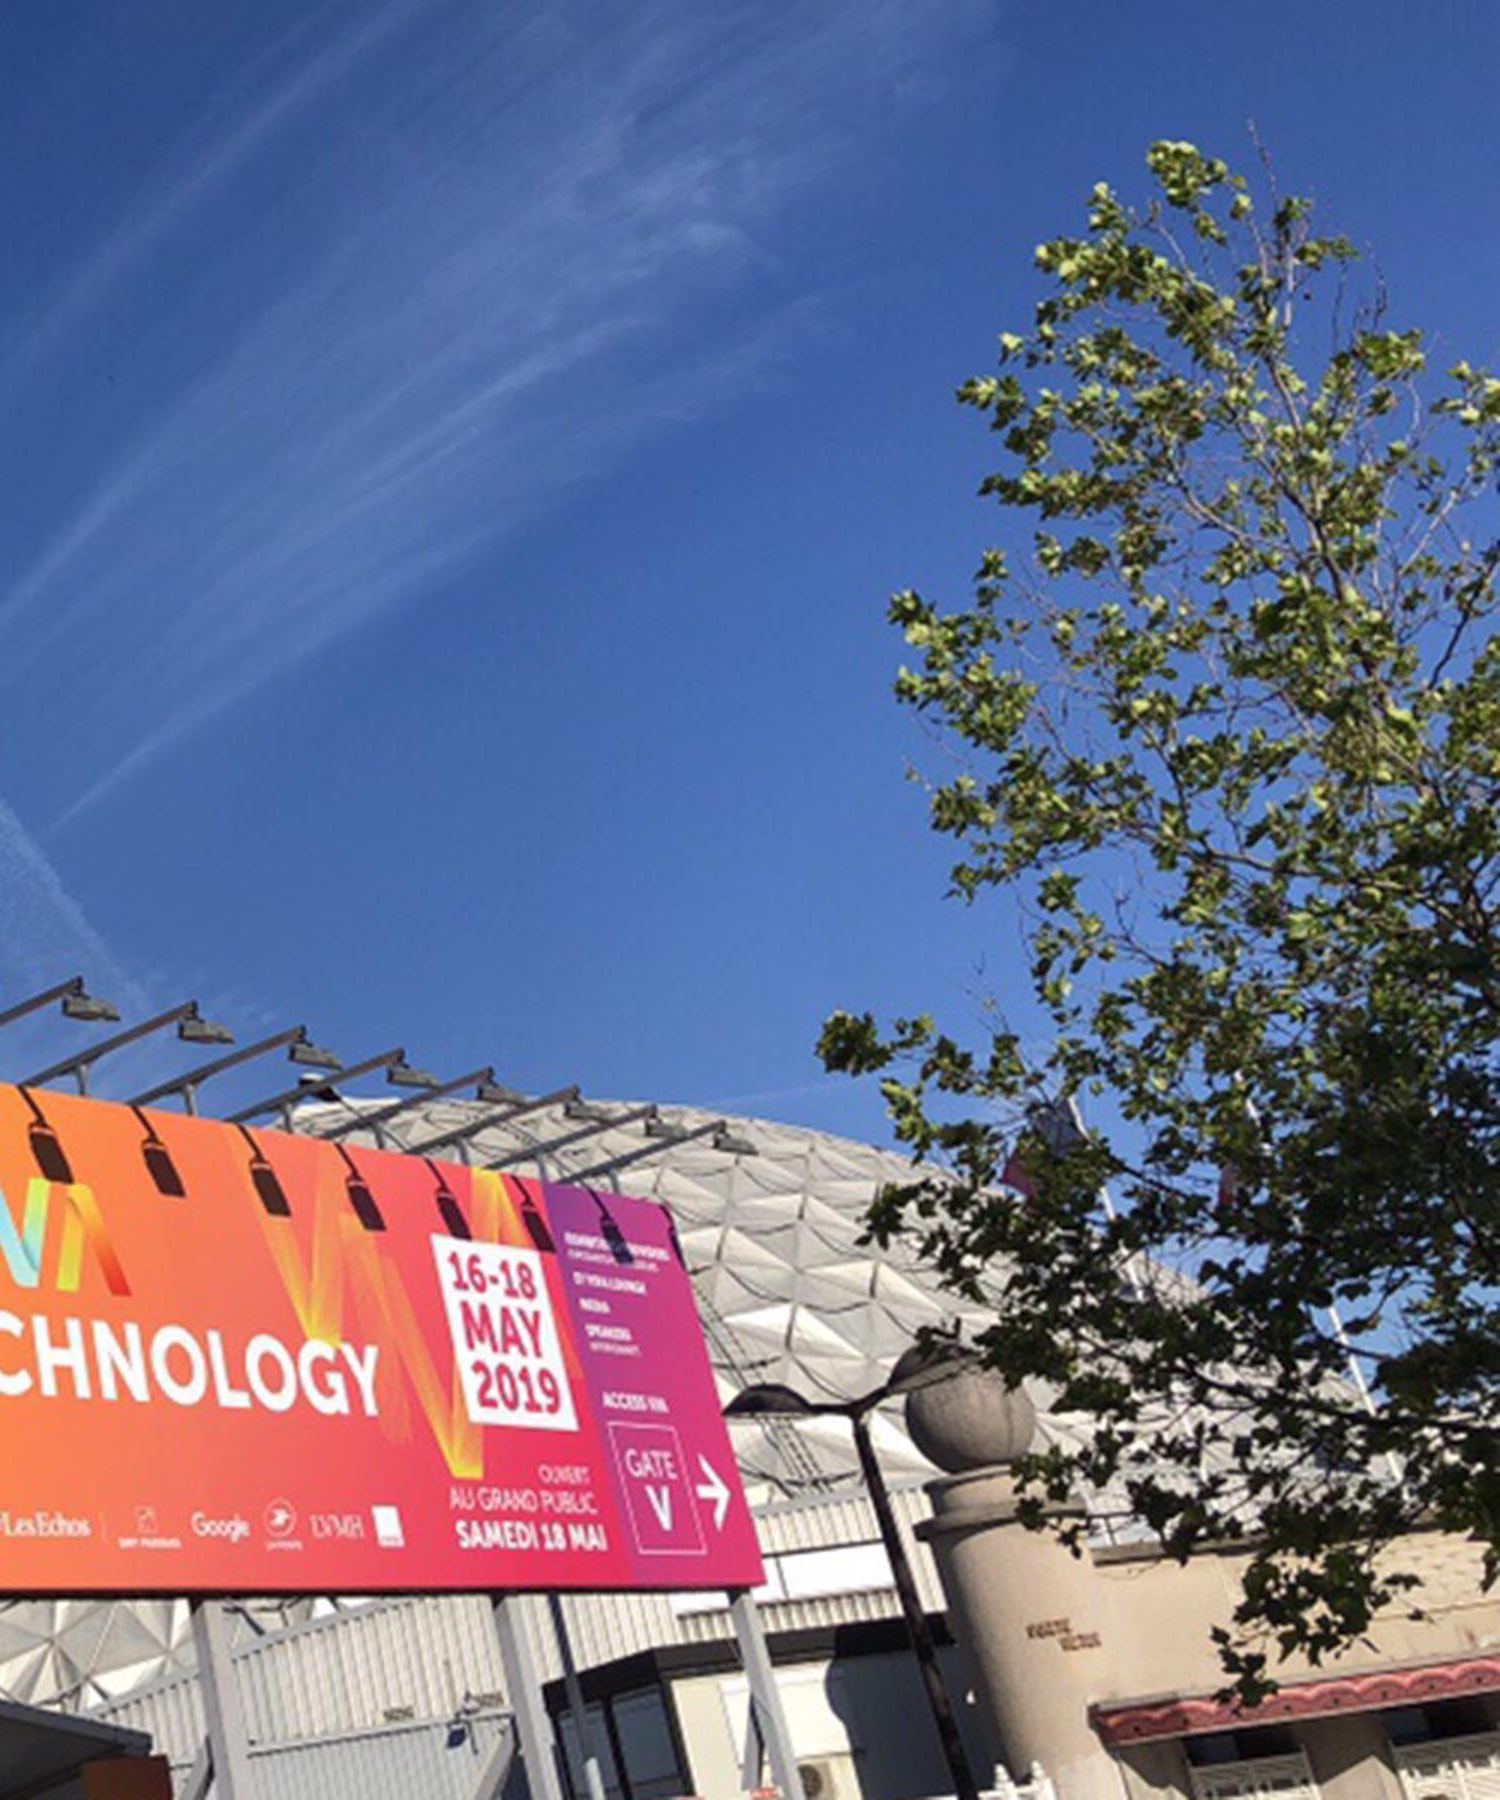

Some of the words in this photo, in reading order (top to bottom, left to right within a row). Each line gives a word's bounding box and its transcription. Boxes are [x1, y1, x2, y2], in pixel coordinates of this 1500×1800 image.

[448, 1251, 537, 1300] 16-18
[460, 1300, 542, 1358] MAY
[471, 1360, 560, 1415] 2019
[625, 1448, 678, 1480] GATE
[450, 1486, 475, 1511] AU
[476, 1486, 538, 1513] GRAND
[539, 1489, 599, 1515] PUBLIC
[644, 1484, 673, 1532] V
[191, 1510, 250, 1544] Google
[455, 1519, 540, 1549] SAMEDI
[540, 1522, 568, 1551] 18
[567, 1523, 609, 1551] MAI
